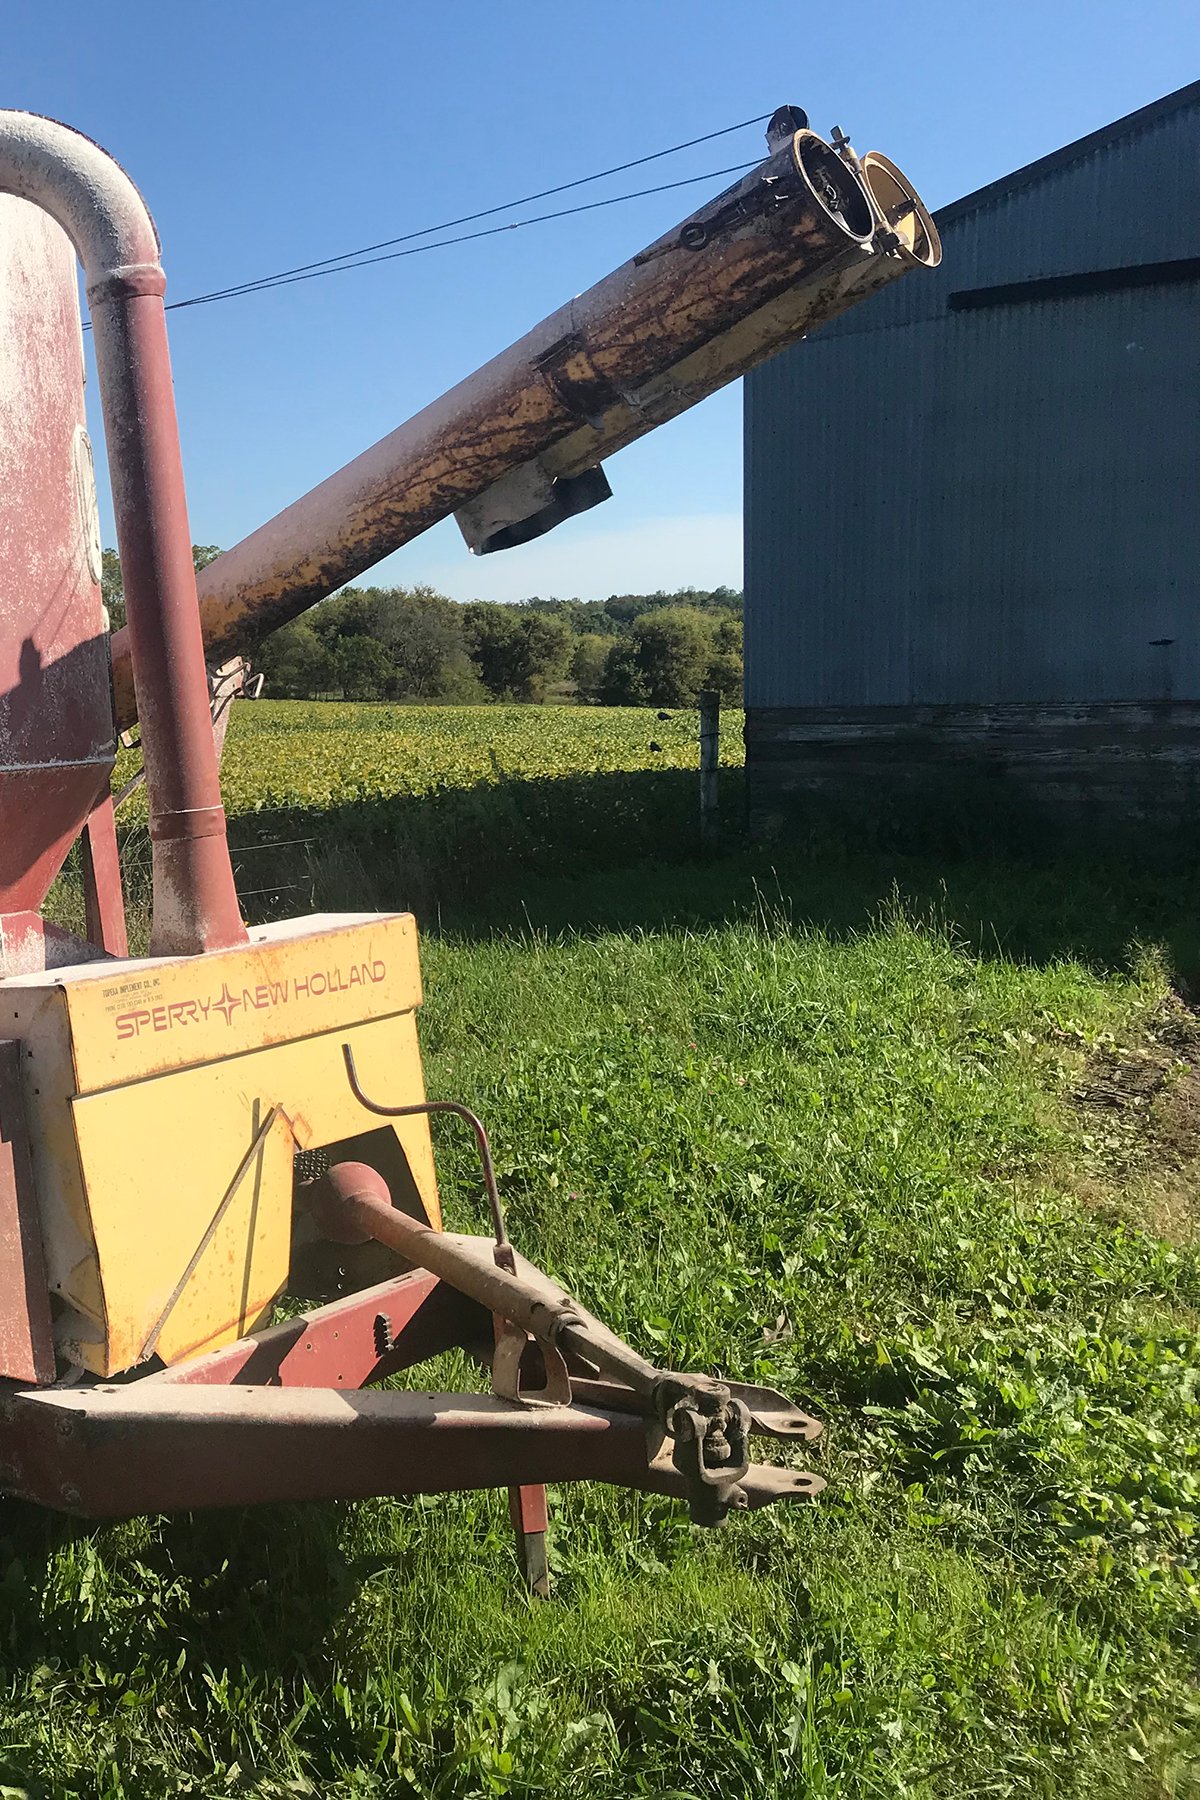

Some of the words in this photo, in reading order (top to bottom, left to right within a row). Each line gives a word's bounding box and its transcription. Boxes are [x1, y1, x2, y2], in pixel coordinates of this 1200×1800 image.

[115, 996, 211, 1040] SPERRY
[242, 981, 289, 1012] NEW
[294, 960, 386, 1000] HOLLAND
[119, 982, 143, 994] IMPLEMENT
